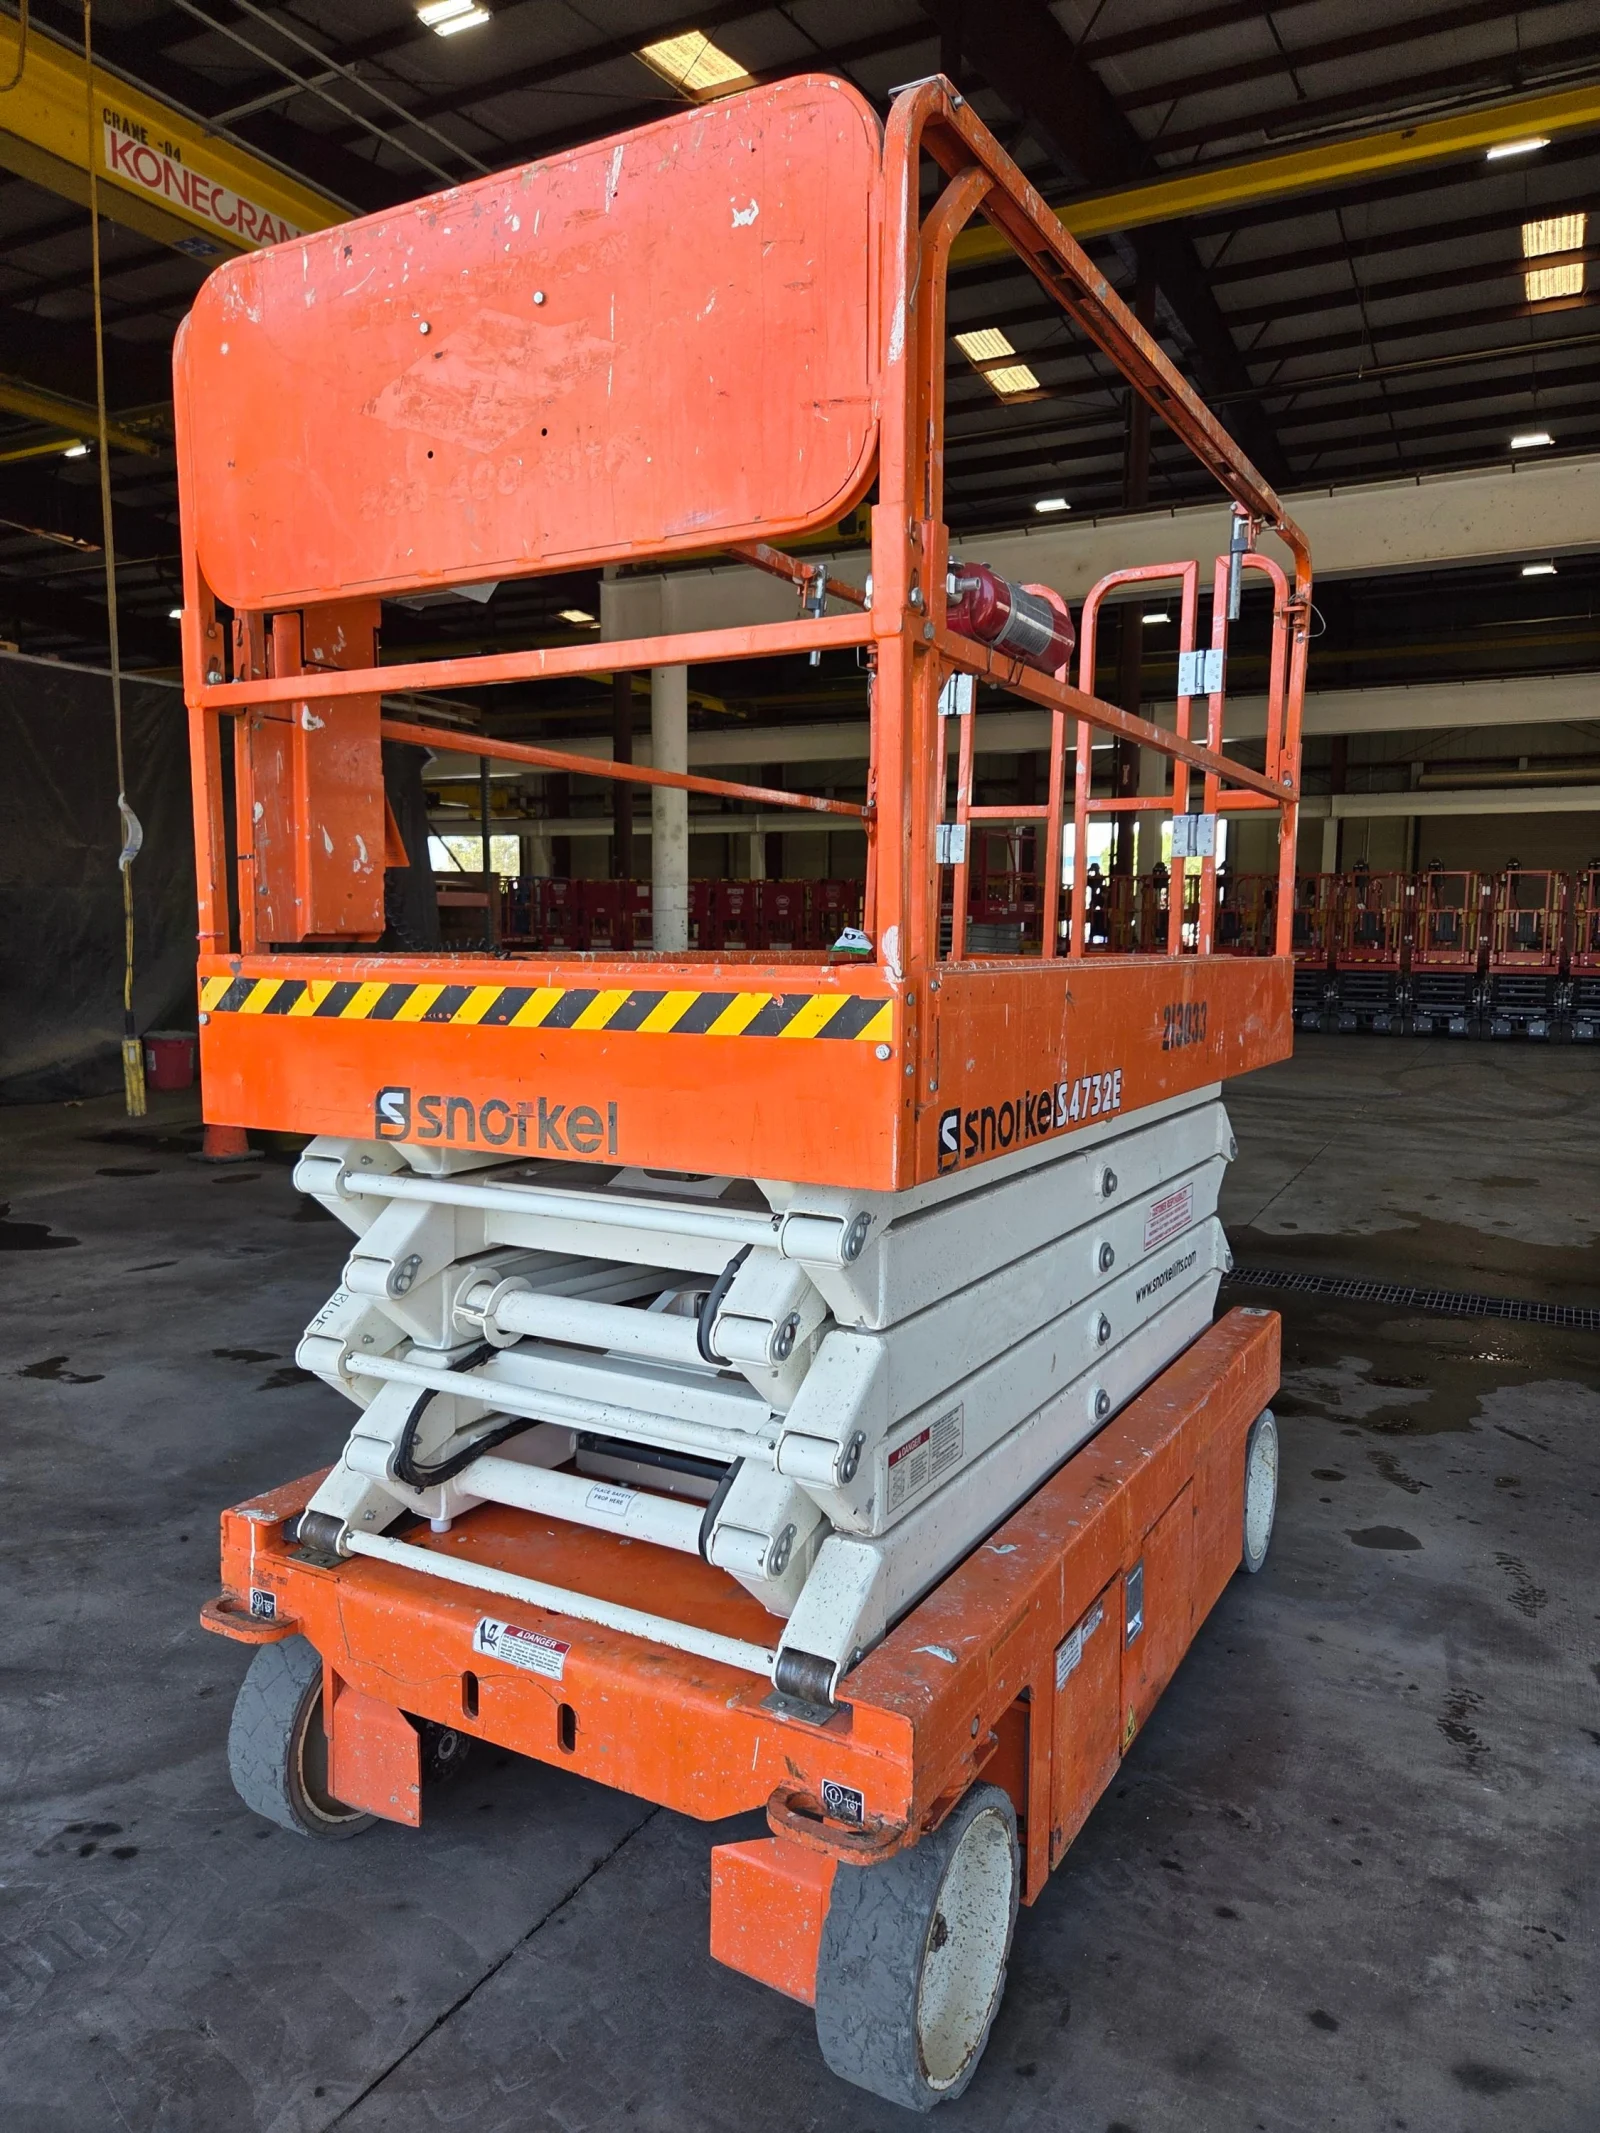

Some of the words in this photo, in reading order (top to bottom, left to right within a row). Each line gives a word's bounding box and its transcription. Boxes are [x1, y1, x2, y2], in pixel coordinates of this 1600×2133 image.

[103, 107, 148, 146] CRANE
[964, 1083, 1058, 1158] snorkel
[1057, 1068, 1122, 1128] S4732E
[417, 1096, 617, 1156] snorkel
[308, 1292, 349, 1332] BLUE
[523, 1632, 557, 1649] DANGER
